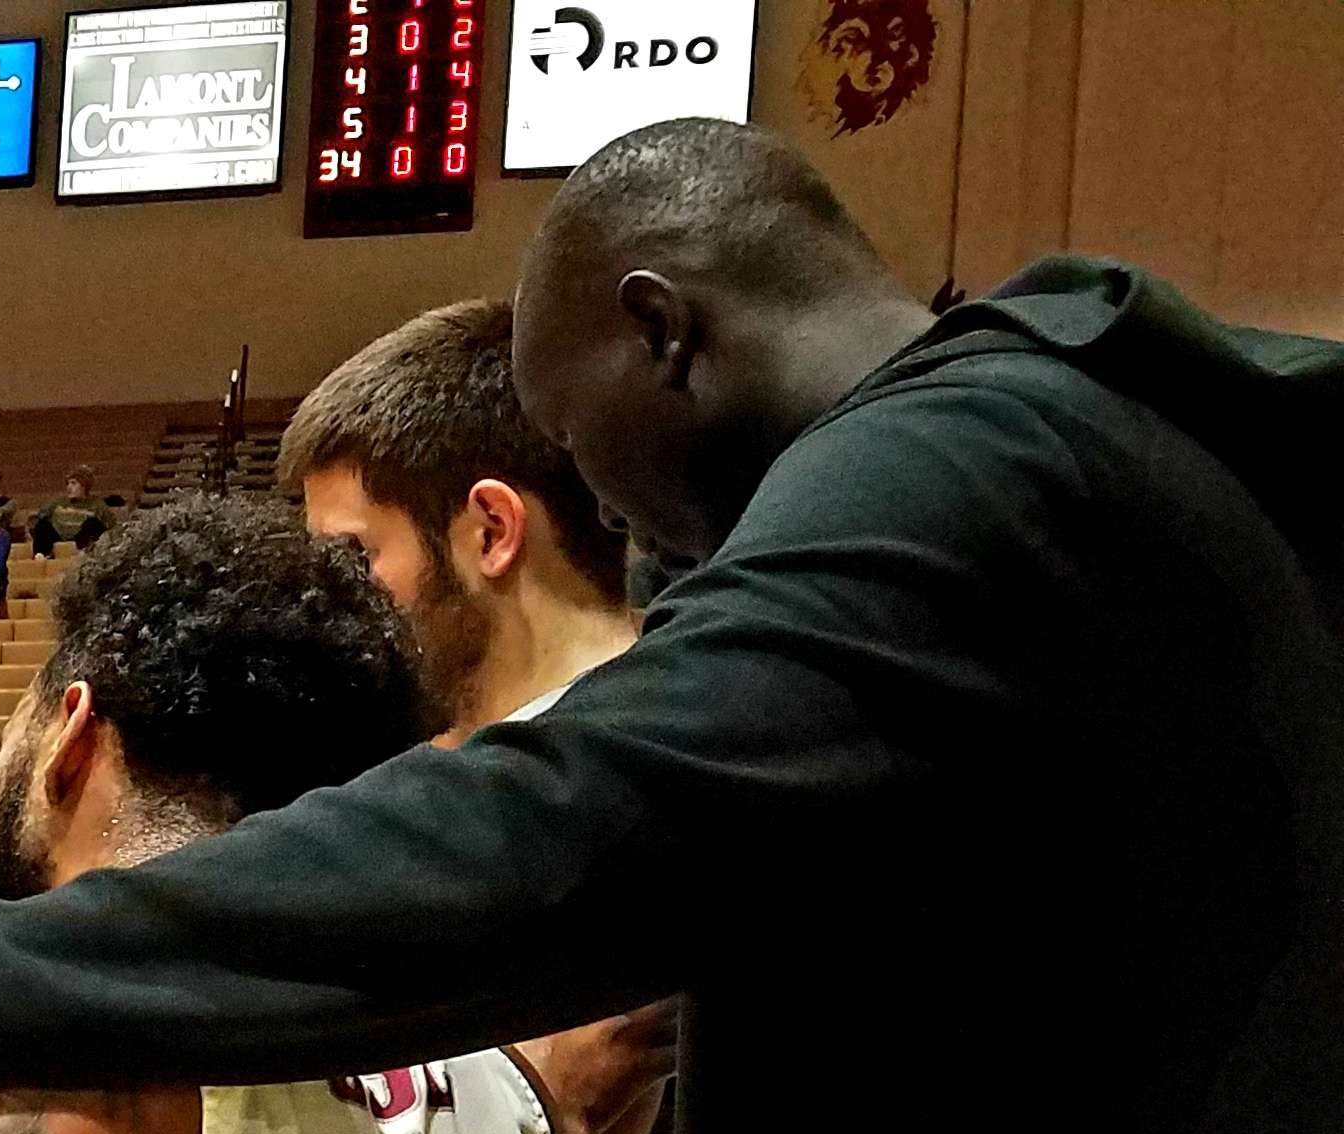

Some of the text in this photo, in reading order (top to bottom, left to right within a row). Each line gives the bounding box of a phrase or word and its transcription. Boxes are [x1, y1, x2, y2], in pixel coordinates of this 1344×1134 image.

[349, 19, 472, 56] 3 0 2
[345, 60, 472, 95] 4 1 4
[71, 104, 270, 157] COMPANIES
[343, 102, 468, 139] 5 1 3
[319, 143, 466, 181] 34 0 0
